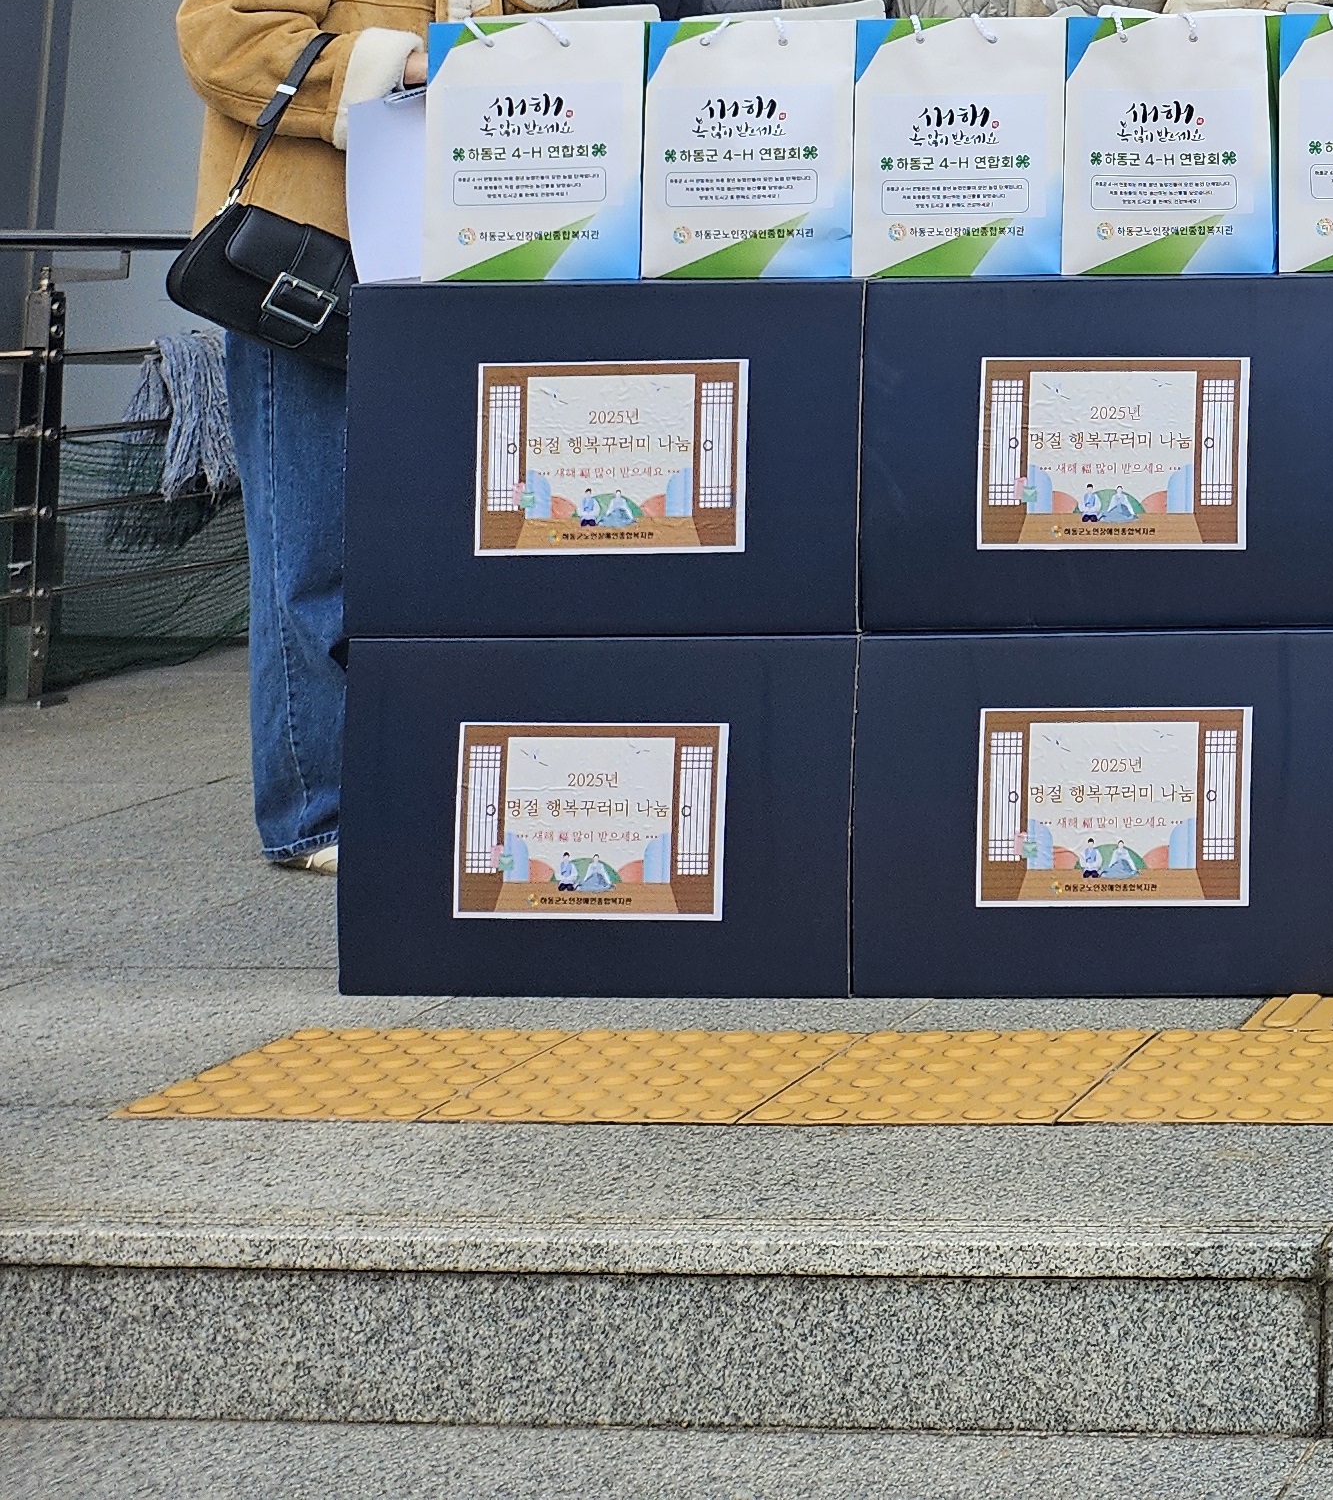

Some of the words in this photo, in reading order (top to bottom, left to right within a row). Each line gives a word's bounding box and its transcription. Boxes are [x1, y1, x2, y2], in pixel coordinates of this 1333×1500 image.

[489, 91, 563, 119] 새해
[701, 94, 776, 121] 새해
[1124, 99, 1193, 124] 새해
[918, 103, 989, 128] 새해
[479, 115, 497, 138] 복
[524, 117, 574, 136] 받으세요
[467, 147, 507, 161] 하동군
[511, 146, 542, 159] 4-H
[548, 144, 590, 159] 연합회
[678, 149, 718, 163] 하동군
[723, 149, 754, 161] 4-H
[760, 147, 802, 161] 연합회
[1104, 153, 1141, 166] 하동군
[1145, 153, 1174, 165] 4-H
[1180, 152, 1220, 166] 연합회
[896, 157, 935, 170] 하동군
[939, 157, 969, 169] 4-H
[974, 155, 1014, 169] 연합회
[478, 230, 599, 242] 하동군노인장애인종합복지관
[694, 228, 814, 240] 하동군노인장애인종합복지관
[909, 227, 1025, 237] 하동군노인장애인종합복지관
[1116, 226, 1233, 237] 하동군노인장애인종합복지관
[588, 409, 639, 425] 2025년
[1090, 405, 1141, 420] 2025년
[528, 437, 560, 455] 명절
[567, 436, 650, 454] 행복꾸러미
[659, 435, 690, 452] 나눔
[1030, 432, 1061, 449] 명절
[1069, 432, 1152, 449] 행복꾸러미
[1160, 432, 1192, 449] 나눔
[1056, 463, 1077, 474] 새해
[1096, 463, 1117, 474] 많이
[1122, 463, 1164, 474] 받으세요
[1091, 757, 1142, 773] 2025년
[568, 771, 618, 787] 2025년
[1030, 785, 1062, 803] 명절
[1069, 785, 1153, 803] 행복꾸러미
[1162, 785, 1194, 802] 나눔
[507, 799, 538, 817] 명절
[546, 799, 629, 817] 행복꾸러미
[637, 800, 669, 817] 나눔
